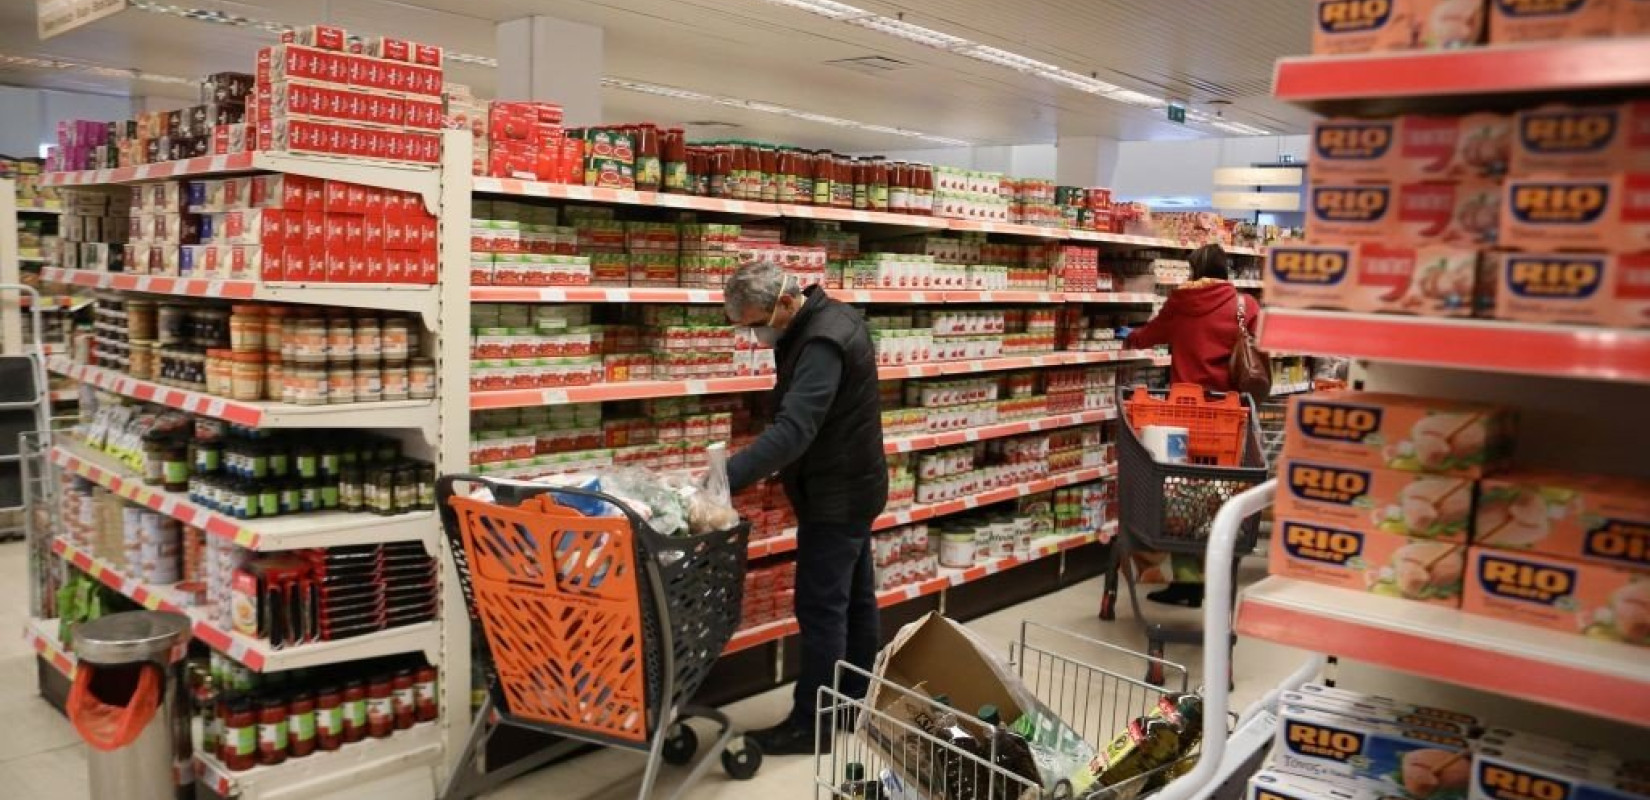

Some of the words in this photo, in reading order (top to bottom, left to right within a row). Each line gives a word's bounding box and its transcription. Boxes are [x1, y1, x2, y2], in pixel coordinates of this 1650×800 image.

[1323, 0, 1387, 22] RIO
[1320, 128, 1387, 150] RIO
[1526, 117, 1608, 141] RIO
[1317, 190, 1384, 211] RIO
[1517, 186, 1601, 211] RIO
[1276, 252, 1343, 273] RIO
[1512, 262, 1596, 286] RIO
[1303, 406, 1375, 430] RIO
[1293, 467, 1364, 492] RIO
[1288, 525, 1358, 553] RIO
[1592, 532, 1650, 560] IO
[1484, 560, 1568, 593] RIO
[1289, 723, 1360, 753] RIO
[1484, 766, 1564, 799] RIO
